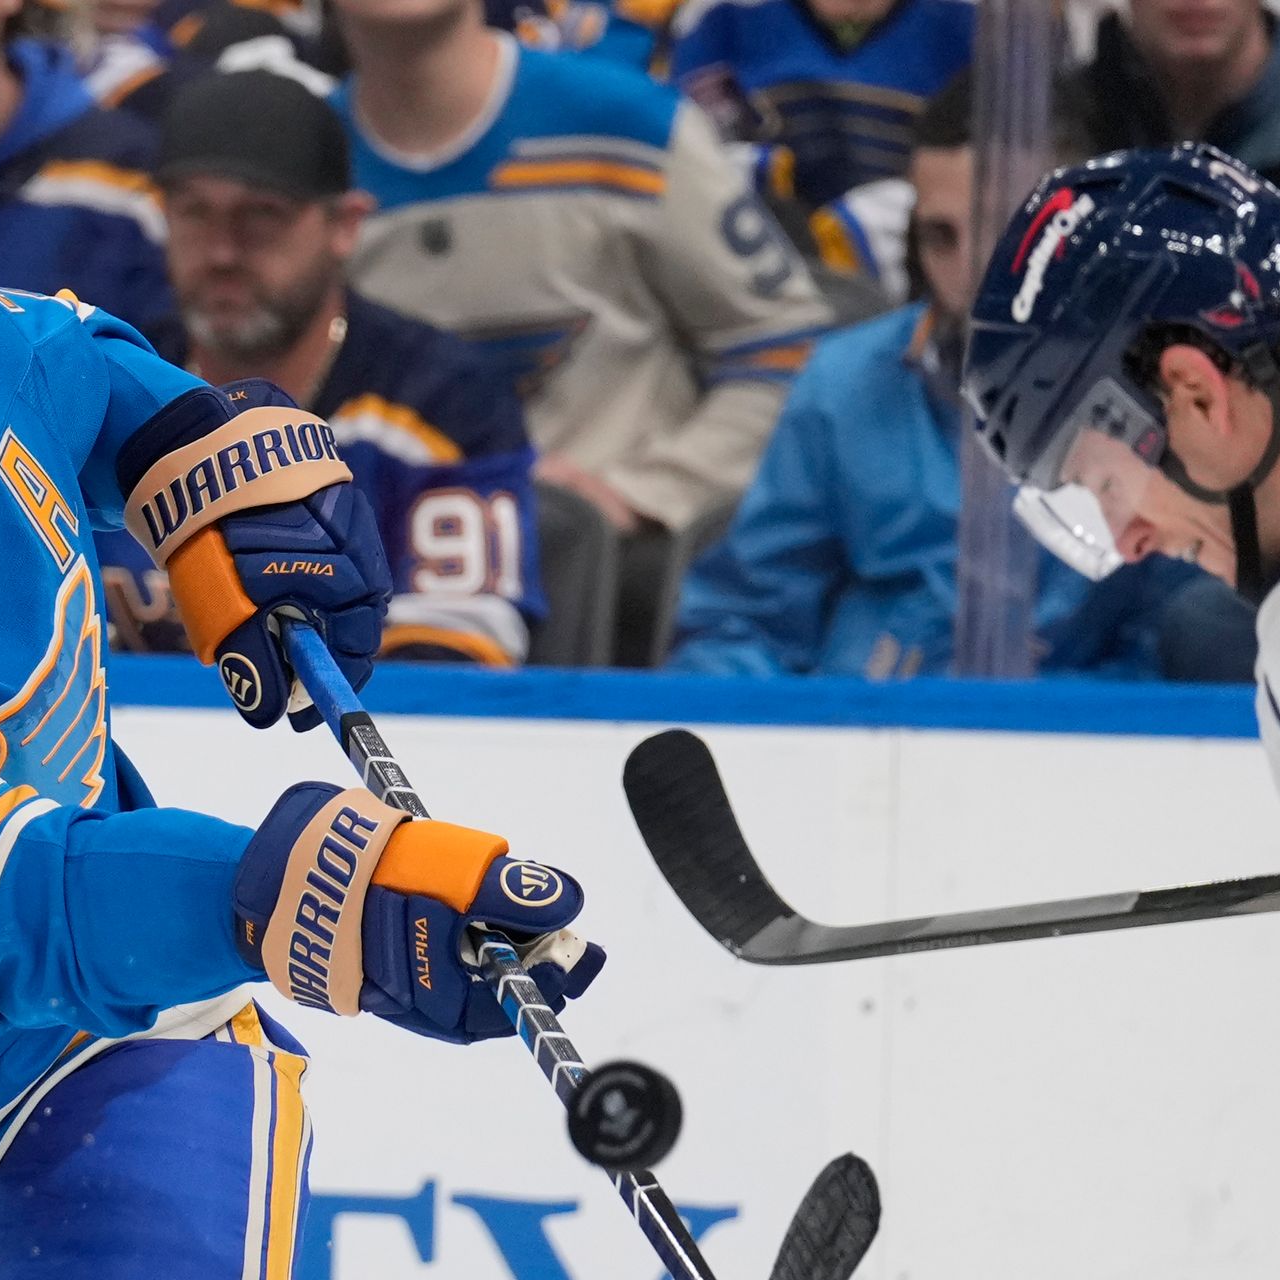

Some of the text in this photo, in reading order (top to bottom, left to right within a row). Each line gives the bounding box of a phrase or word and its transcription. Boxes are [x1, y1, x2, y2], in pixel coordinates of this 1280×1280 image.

[140, 422, 344, 549] WARRIOR
[262, 561, 334, 576] ALPHA
[411, 488, 521, 599] 91
[286, 804, 381, 1018] WARRIOR
[414, 917, 433, 991] ALPHA
